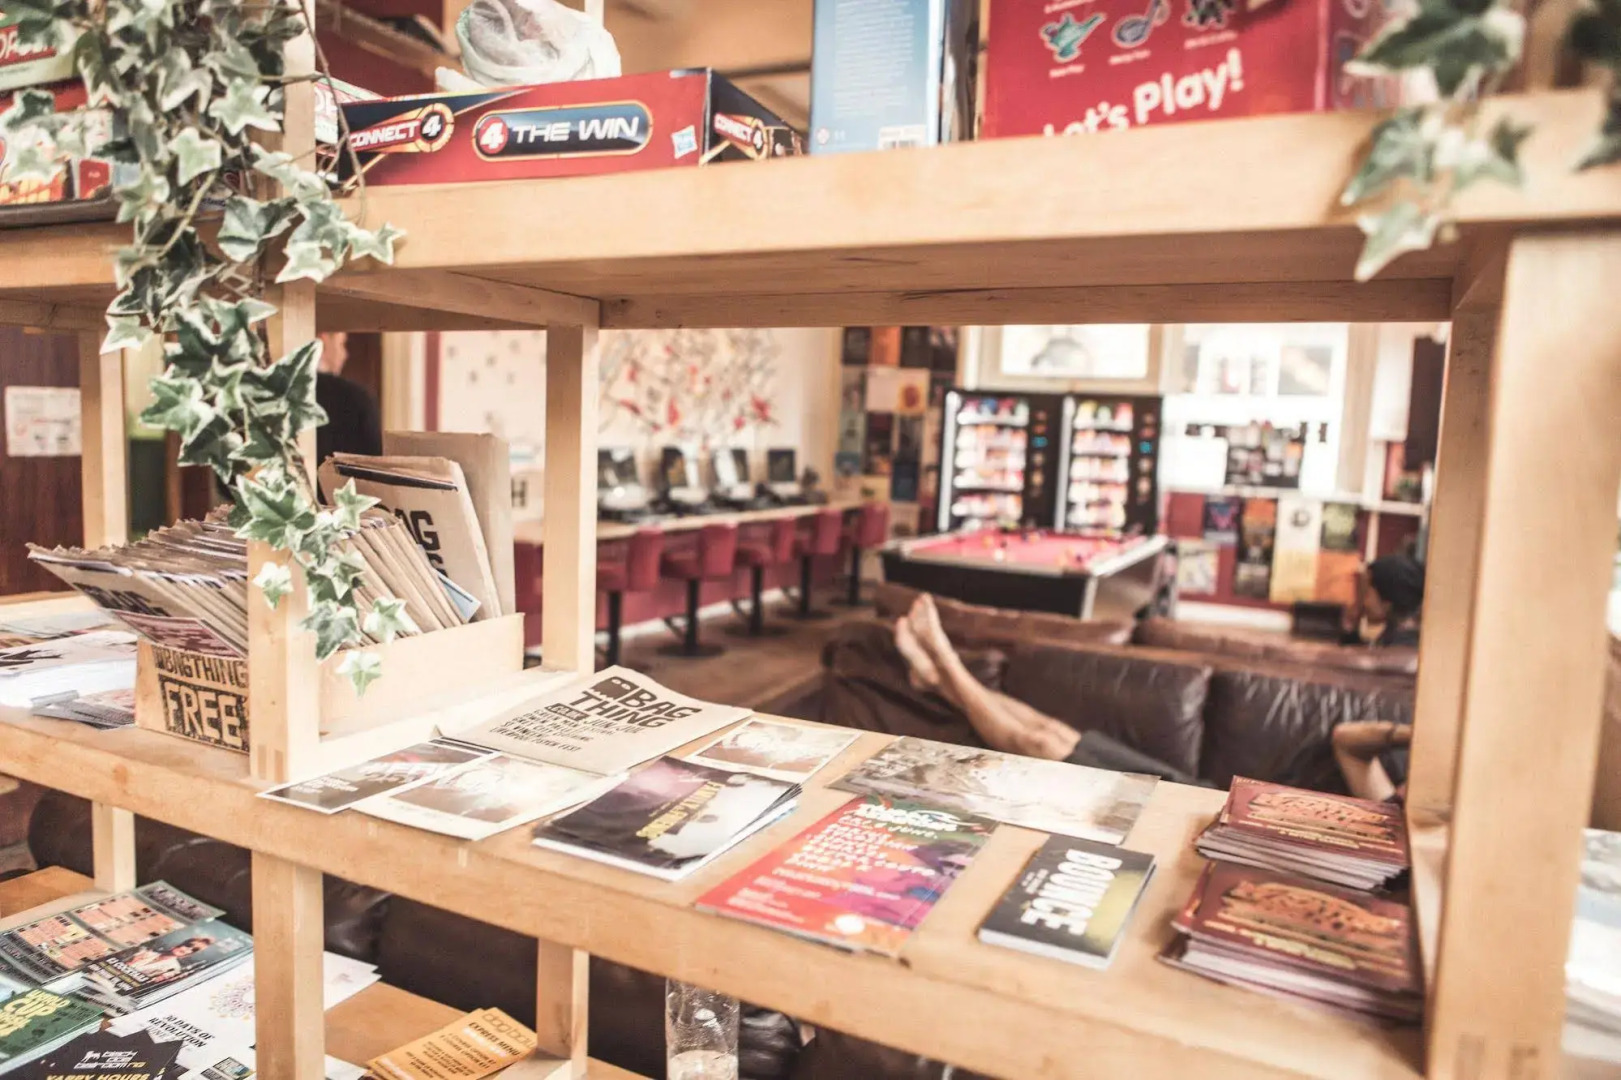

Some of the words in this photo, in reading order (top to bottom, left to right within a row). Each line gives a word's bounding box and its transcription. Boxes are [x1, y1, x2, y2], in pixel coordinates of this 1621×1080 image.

[1133, 48, 1244, 125] Play!
[350, 120, 421, 148] CONNECT
[422, 115, 442, 137] 4
[480, 122, 503, 149] 4
[512, 121, 571, 143] THE
[578, 116, 639, 141] WIN
[163, 681, 242, 747] FREE
[569, 690, 674, 728] THING
[618, 688, 703, 719] BAG
[1020, 848, 1123, 936] BOUNCE
[3, 997, 57, 1017] CUP
[147, 1016, 207, 1048] REVOLUTION
[173, 1019, 201, 1034] DAYS
[498, 1041, 521, 1056] MENU
